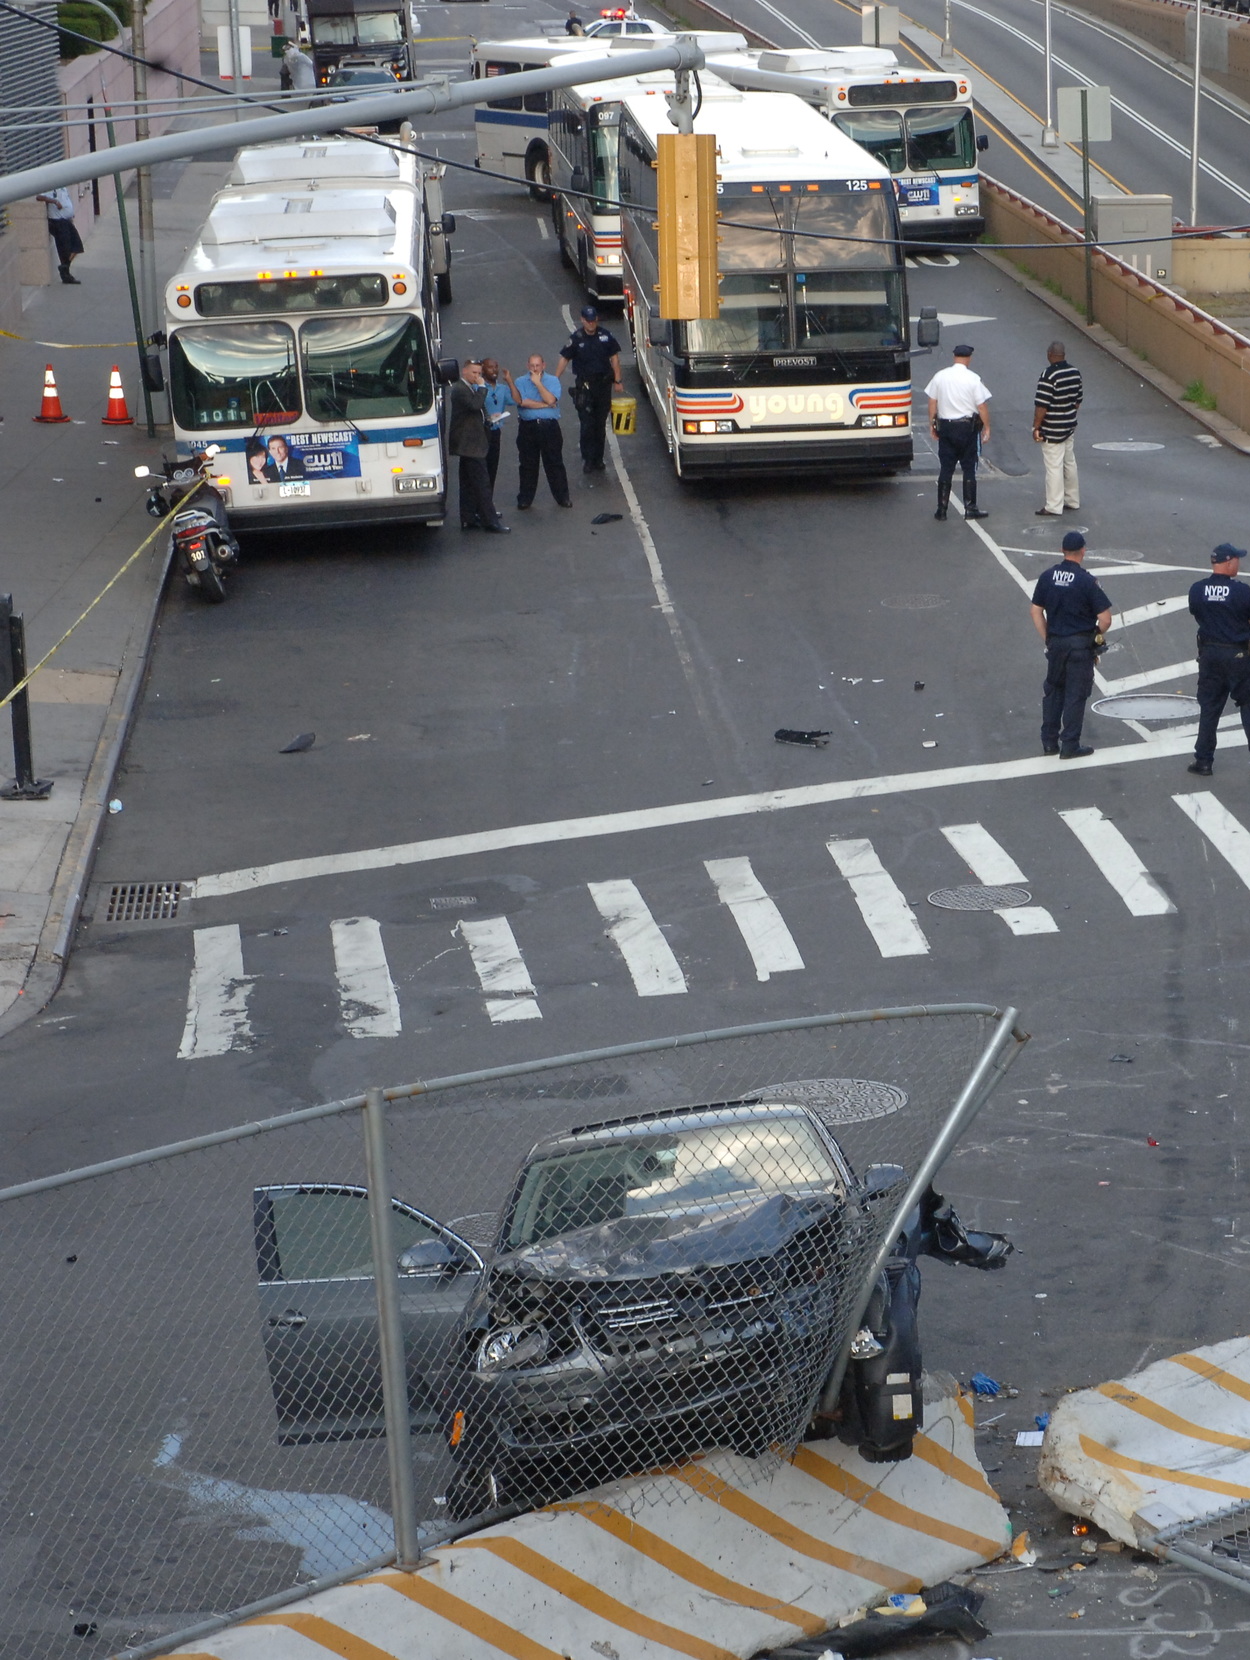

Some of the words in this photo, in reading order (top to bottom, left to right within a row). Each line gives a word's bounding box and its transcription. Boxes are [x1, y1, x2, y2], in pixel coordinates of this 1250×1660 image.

[598, 111, 614, 120] 097
[846, 180, 868, 191] 125
[775, 358, 816, 367] PREVOST
[748, 392, 844, 423] young
[190, 550, 206, 562] 301
[1052, 570, 1075, 583] NYPD
[1204, 585, 1230, 597] NYPD
